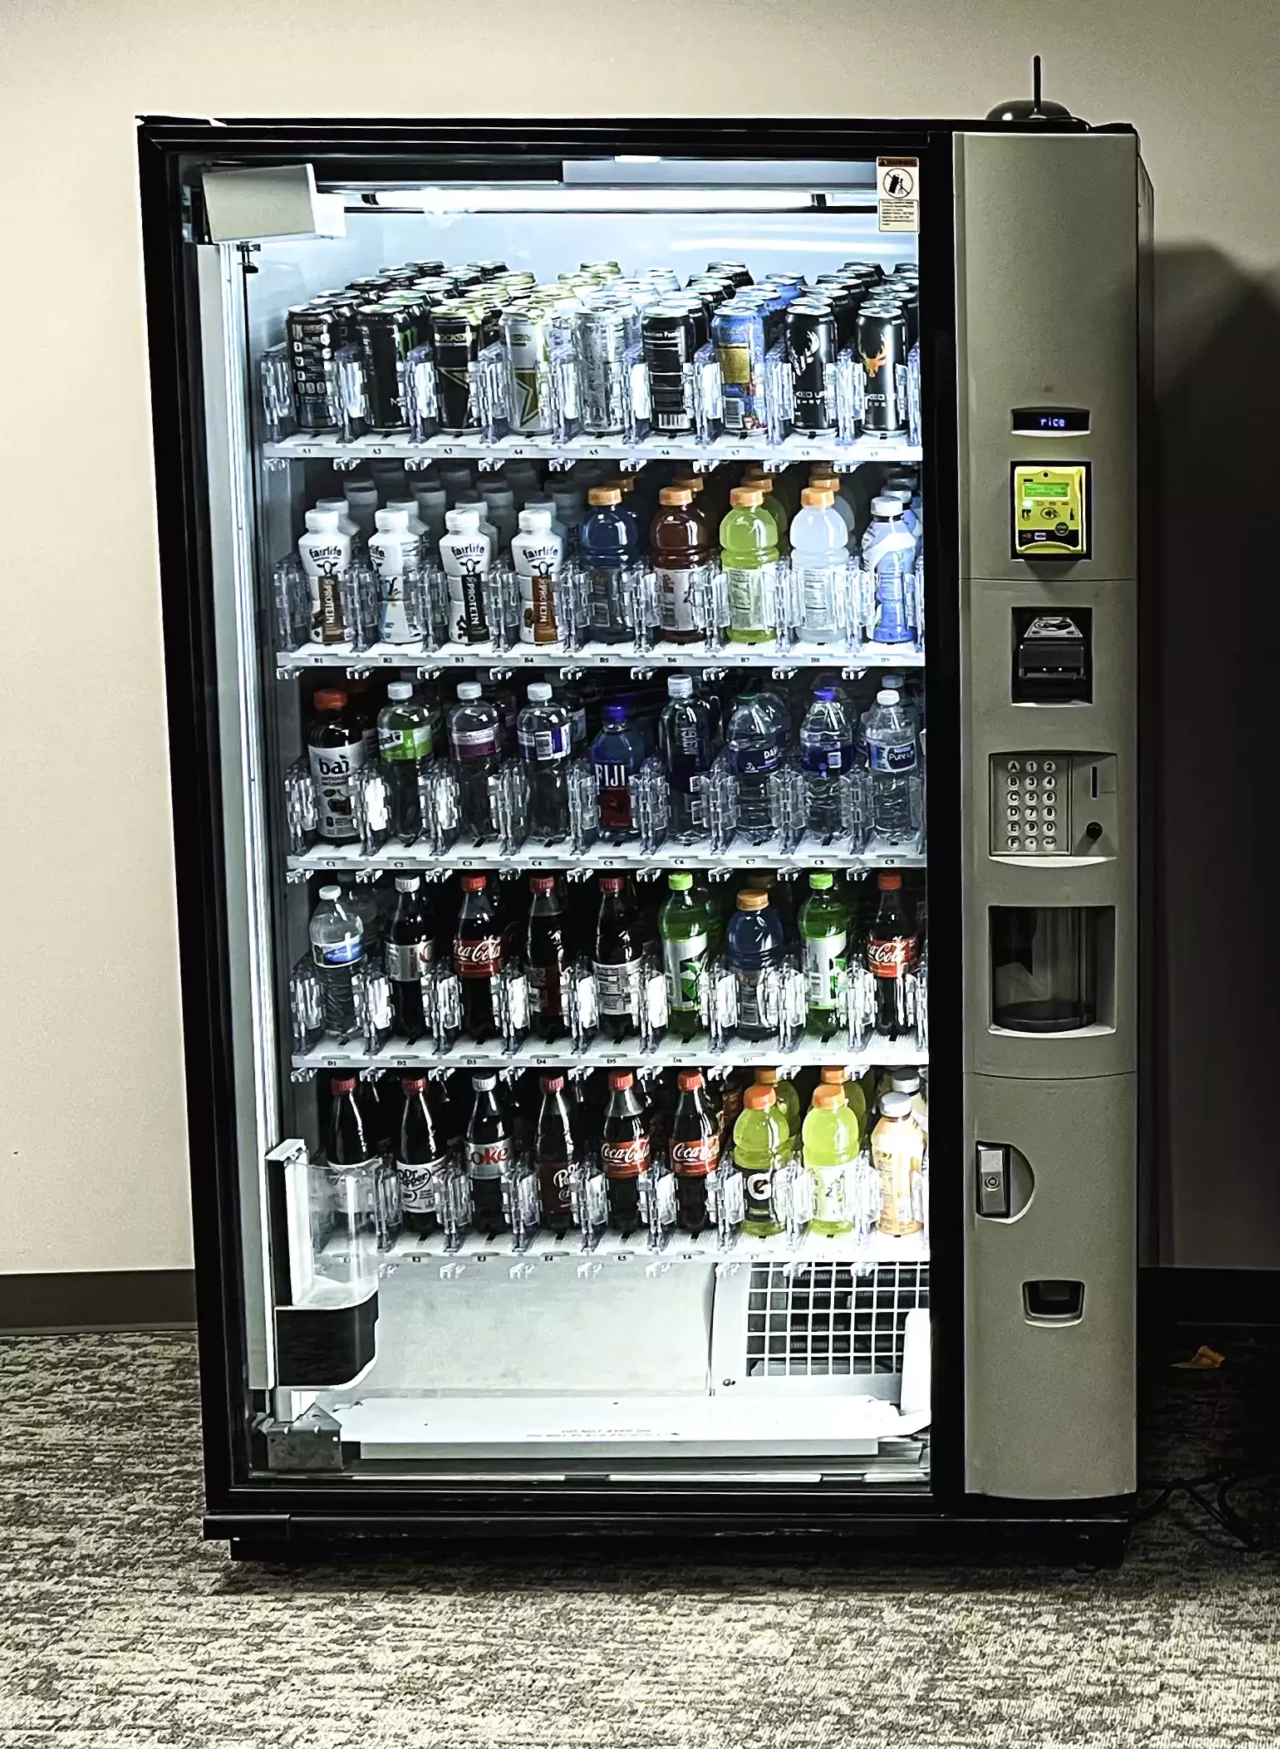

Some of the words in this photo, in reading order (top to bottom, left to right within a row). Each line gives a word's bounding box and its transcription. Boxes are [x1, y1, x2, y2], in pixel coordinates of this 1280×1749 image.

[309, 545, 341, 558] fairlife
[451, 544, 485, 558] fairlife
[522, 545, 558, 560] fairlife
[324, 583, 335, 626] PROTEIN
[467, 583, 479, 626] PROTEIN
[538, 584, 548, 626] PROTEIN
[319, 755, 350, 775] bai
[1010, 763, 1018, 771] A
[1046, 763, 1053, 771] 2
[595, 763, 626, 787] FIJI
[1010, 778, 1017, 786] B
[1028, 778, 1035, 786] 3
[1046, 778, 1053, 786] 4
[1010, 793, 1017, 801] C
[1028, 793, 1035, 801] 5
[1046, 793, 1053, 801] 6
[1010, 809, 1018, 817] D
[1028, 809, 1034, 817] 7
[1046, 809, 1053, 817] 8
[1010, 824, 1017, 832] E
[1028, 824, 1035, 832] 9
[1046, 824, 1053, 832] 0
[1010, 839, 1017, 847] F
